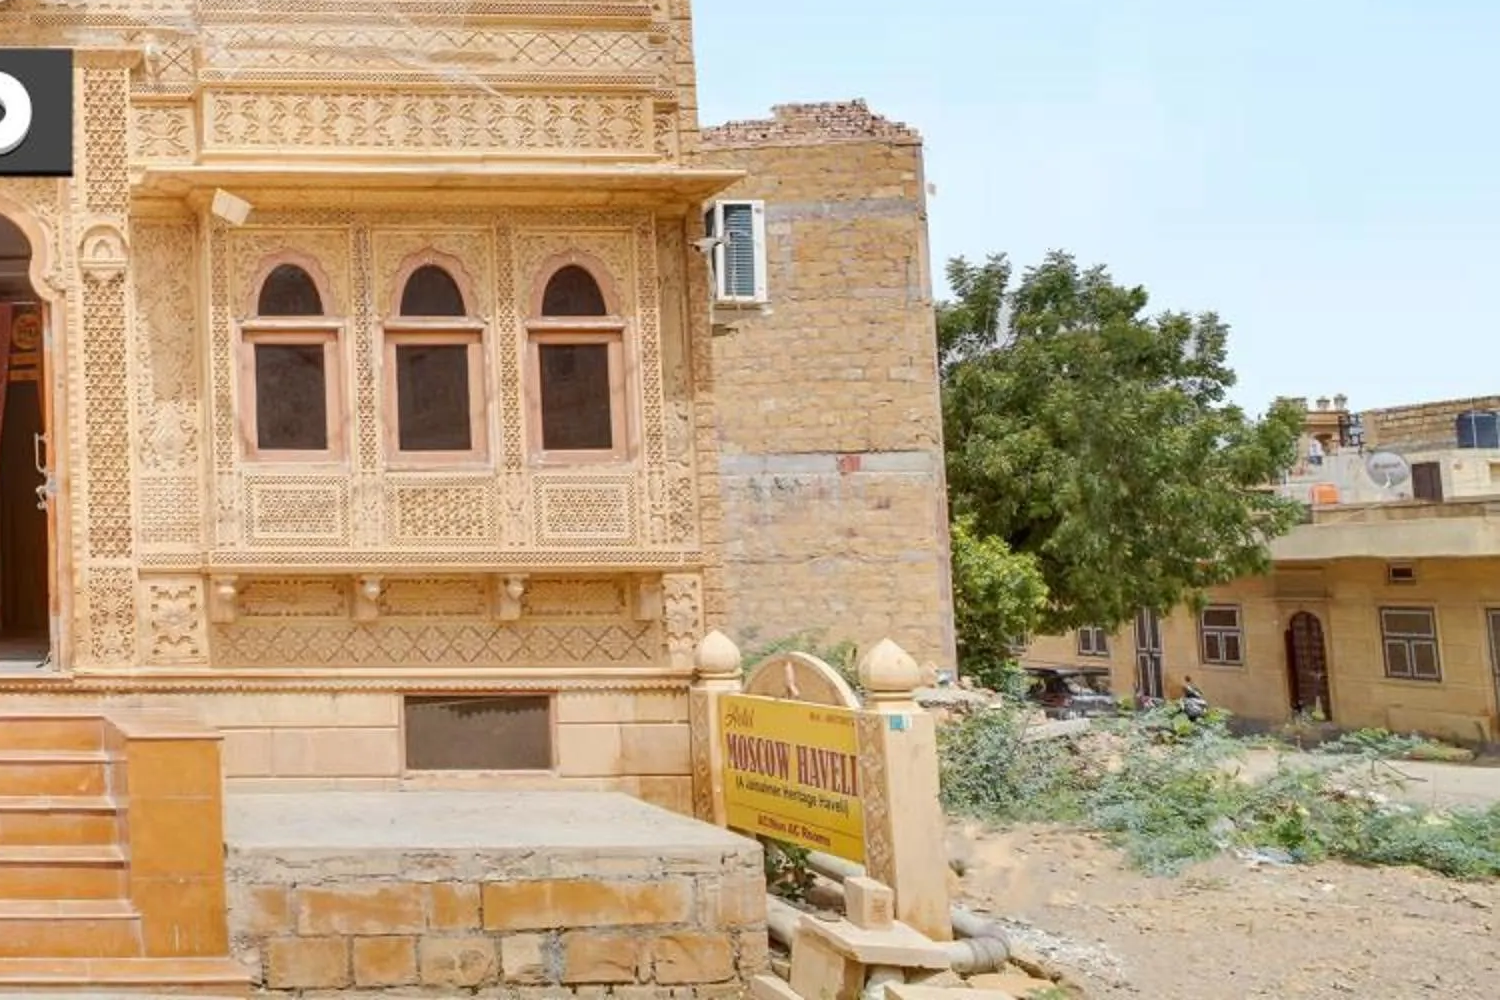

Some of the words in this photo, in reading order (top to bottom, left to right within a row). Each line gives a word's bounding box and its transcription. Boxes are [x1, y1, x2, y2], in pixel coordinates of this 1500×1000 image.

[724, 703, 755, 729] Hotel
[726, 733, 791, 781] MOSCOW
[796, 745, 857, 797] HAVELI
